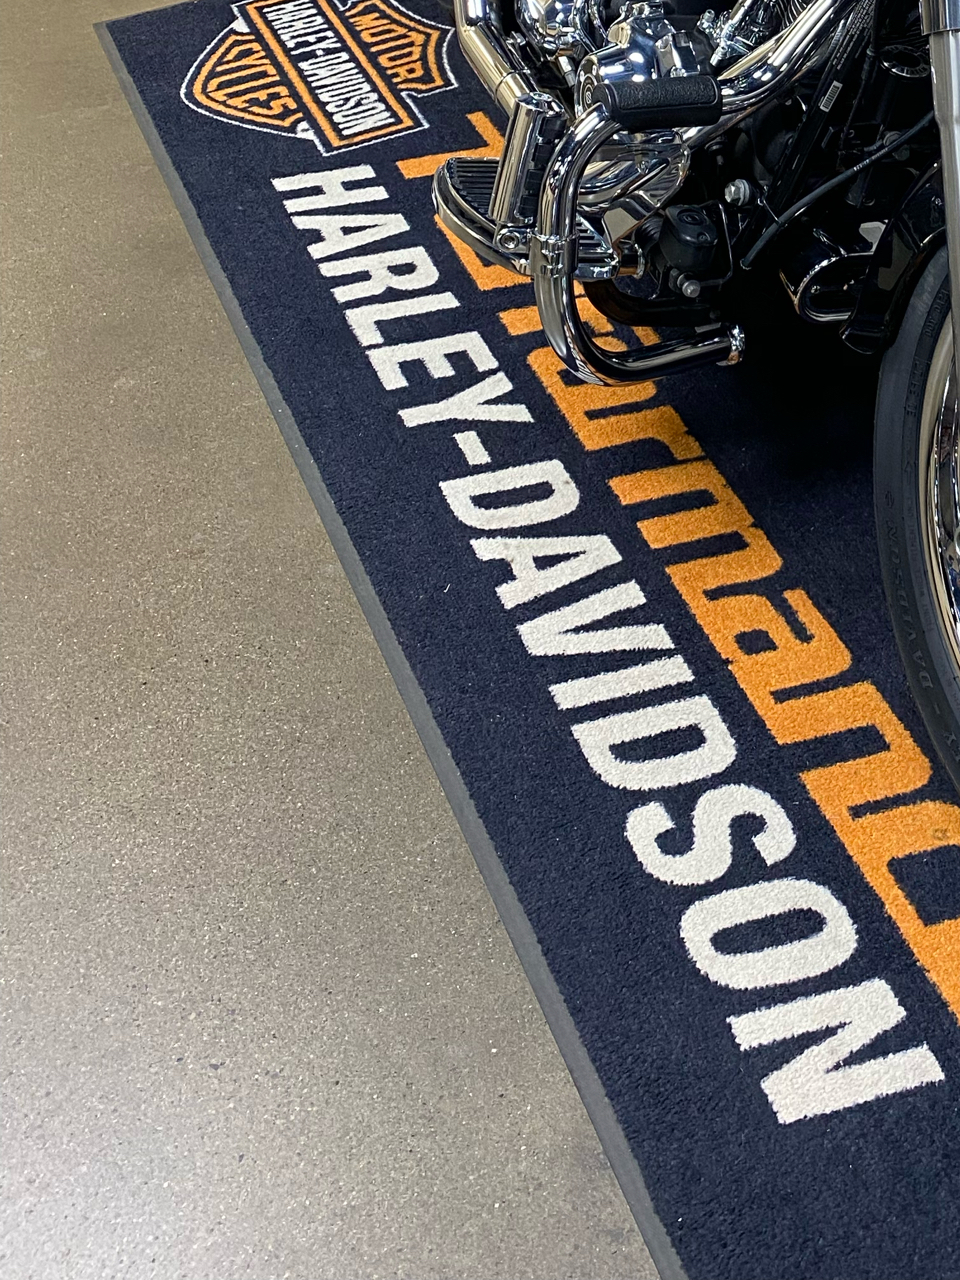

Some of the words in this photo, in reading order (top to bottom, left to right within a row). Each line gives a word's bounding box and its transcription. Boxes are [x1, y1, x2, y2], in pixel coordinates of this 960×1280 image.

[206, 41, 299, 117] CYCLES
[348, 11, 427, 87] MOTOR
[271, 163, 945, 1124] HARLEY-DAVIDSON
